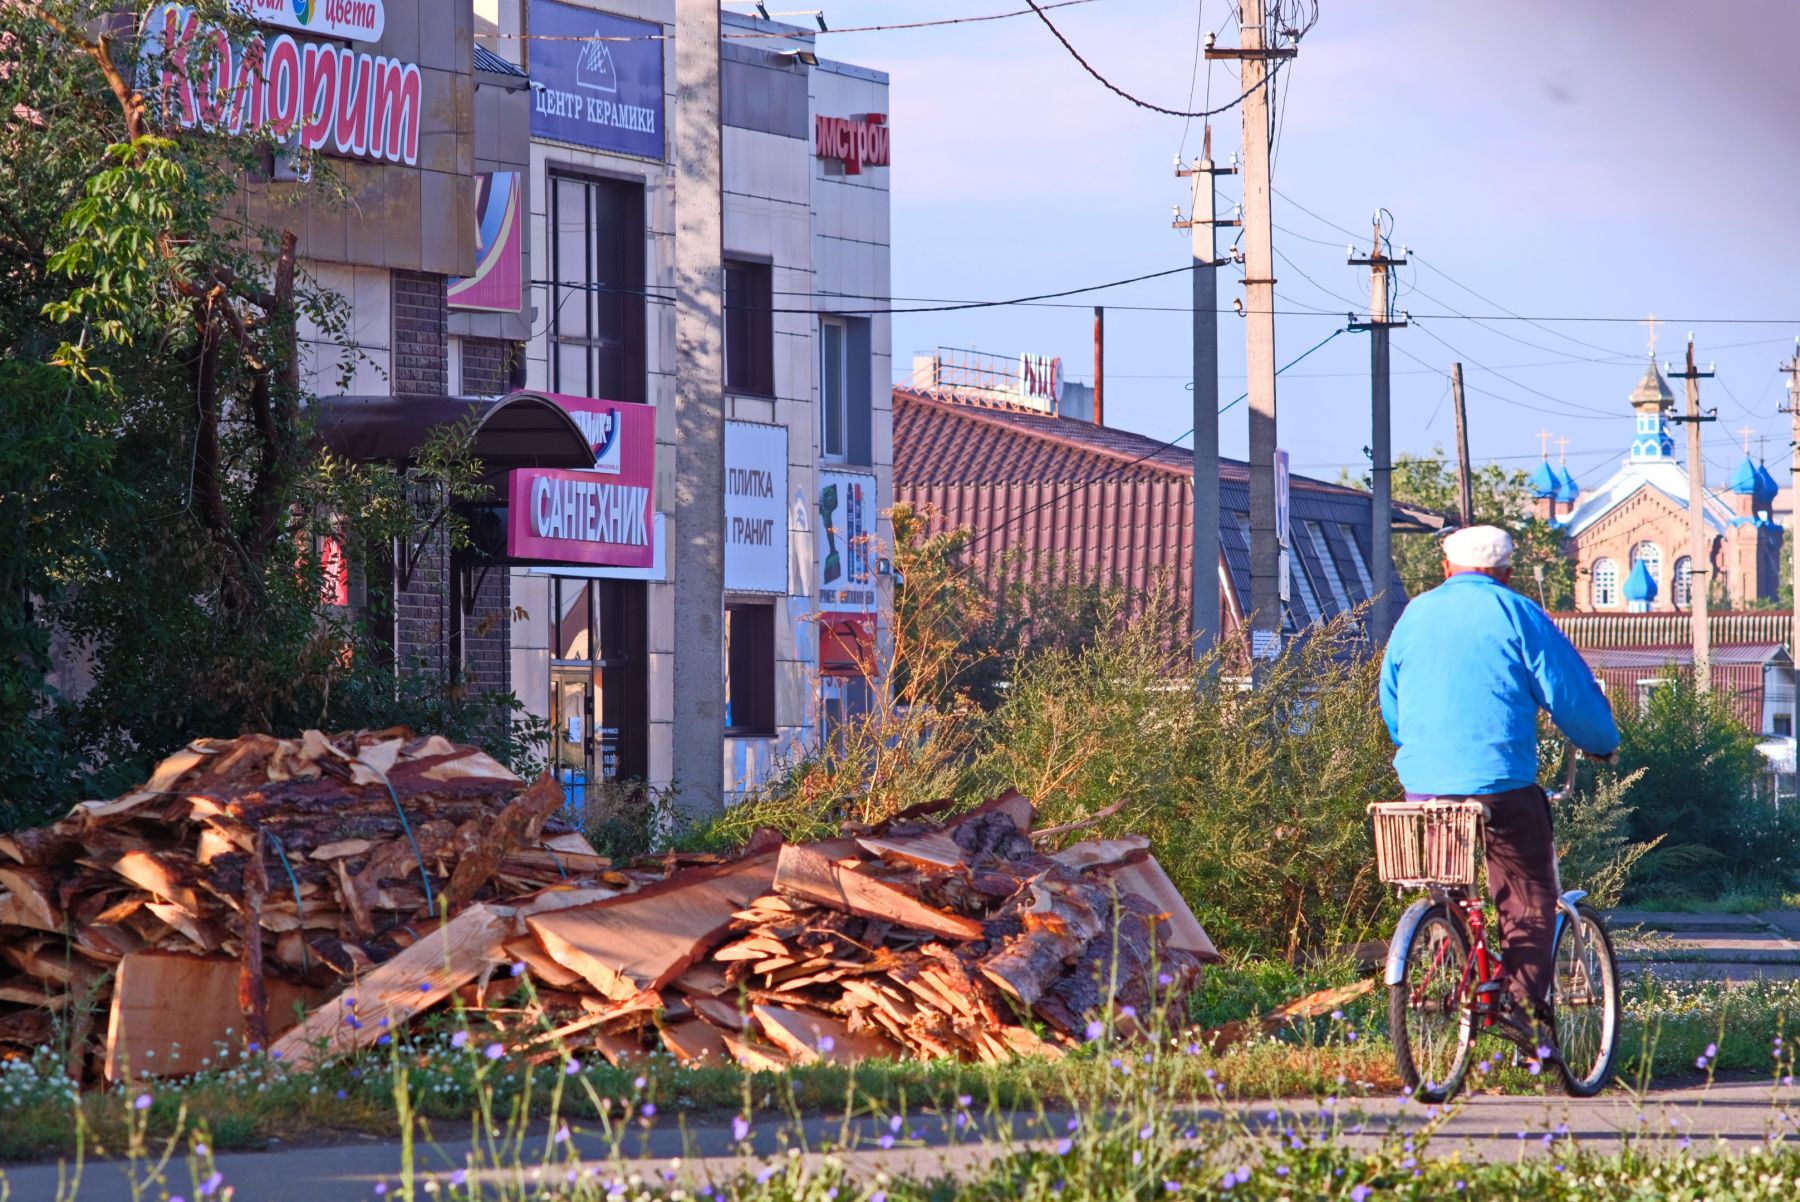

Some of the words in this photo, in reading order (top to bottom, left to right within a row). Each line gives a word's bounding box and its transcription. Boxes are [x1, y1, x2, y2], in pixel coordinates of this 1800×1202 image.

[535, 86, 583, 120] ЦЕНТР
[586, 97, 655, 134] КЕРАМИКИ
[728, 467, 774, 499] ПЛИТКА
[532, 475, 649, 547] САНТЕХНИК
[733, 516, 774, 547] ГРАНИТ
